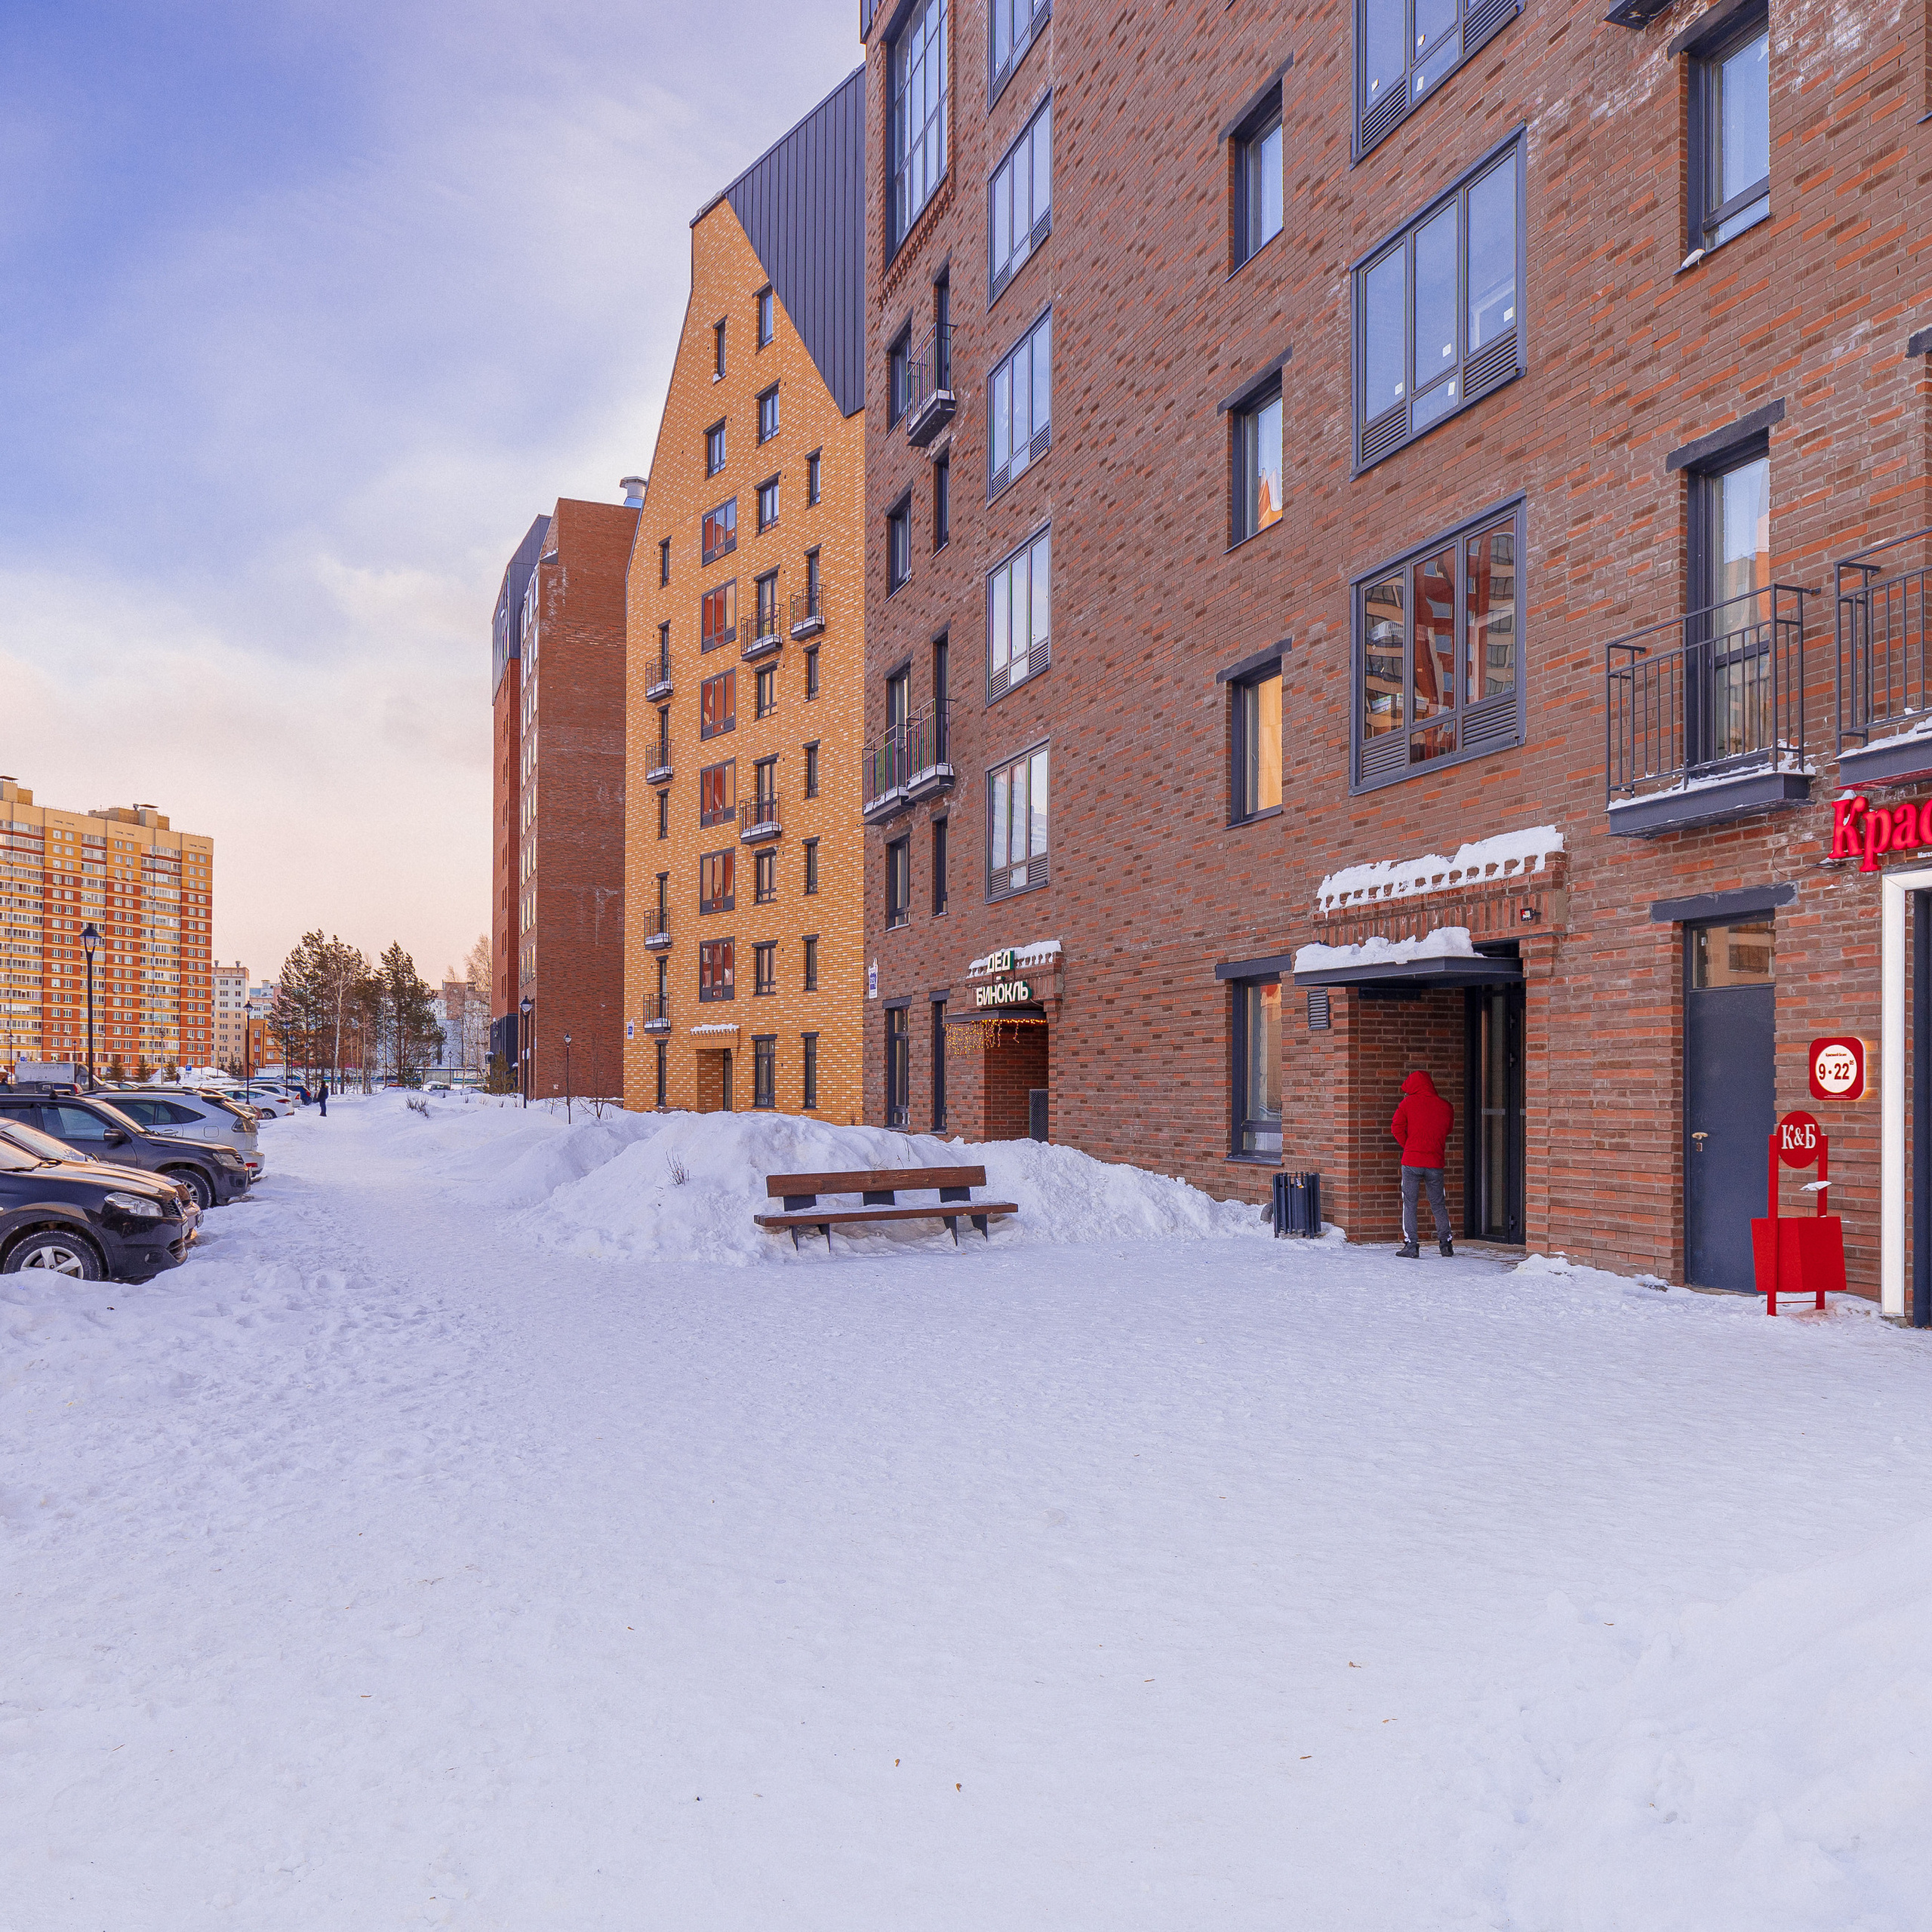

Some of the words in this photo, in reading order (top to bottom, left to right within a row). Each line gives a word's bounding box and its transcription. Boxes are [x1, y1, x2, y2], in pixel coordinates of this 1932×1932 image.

[986, 950, 1012, 973] ДЕД
[976, 981, 1029, 1006] БИНОКЛЬ
[1781, 1124, 1817, 1149] К&Б
